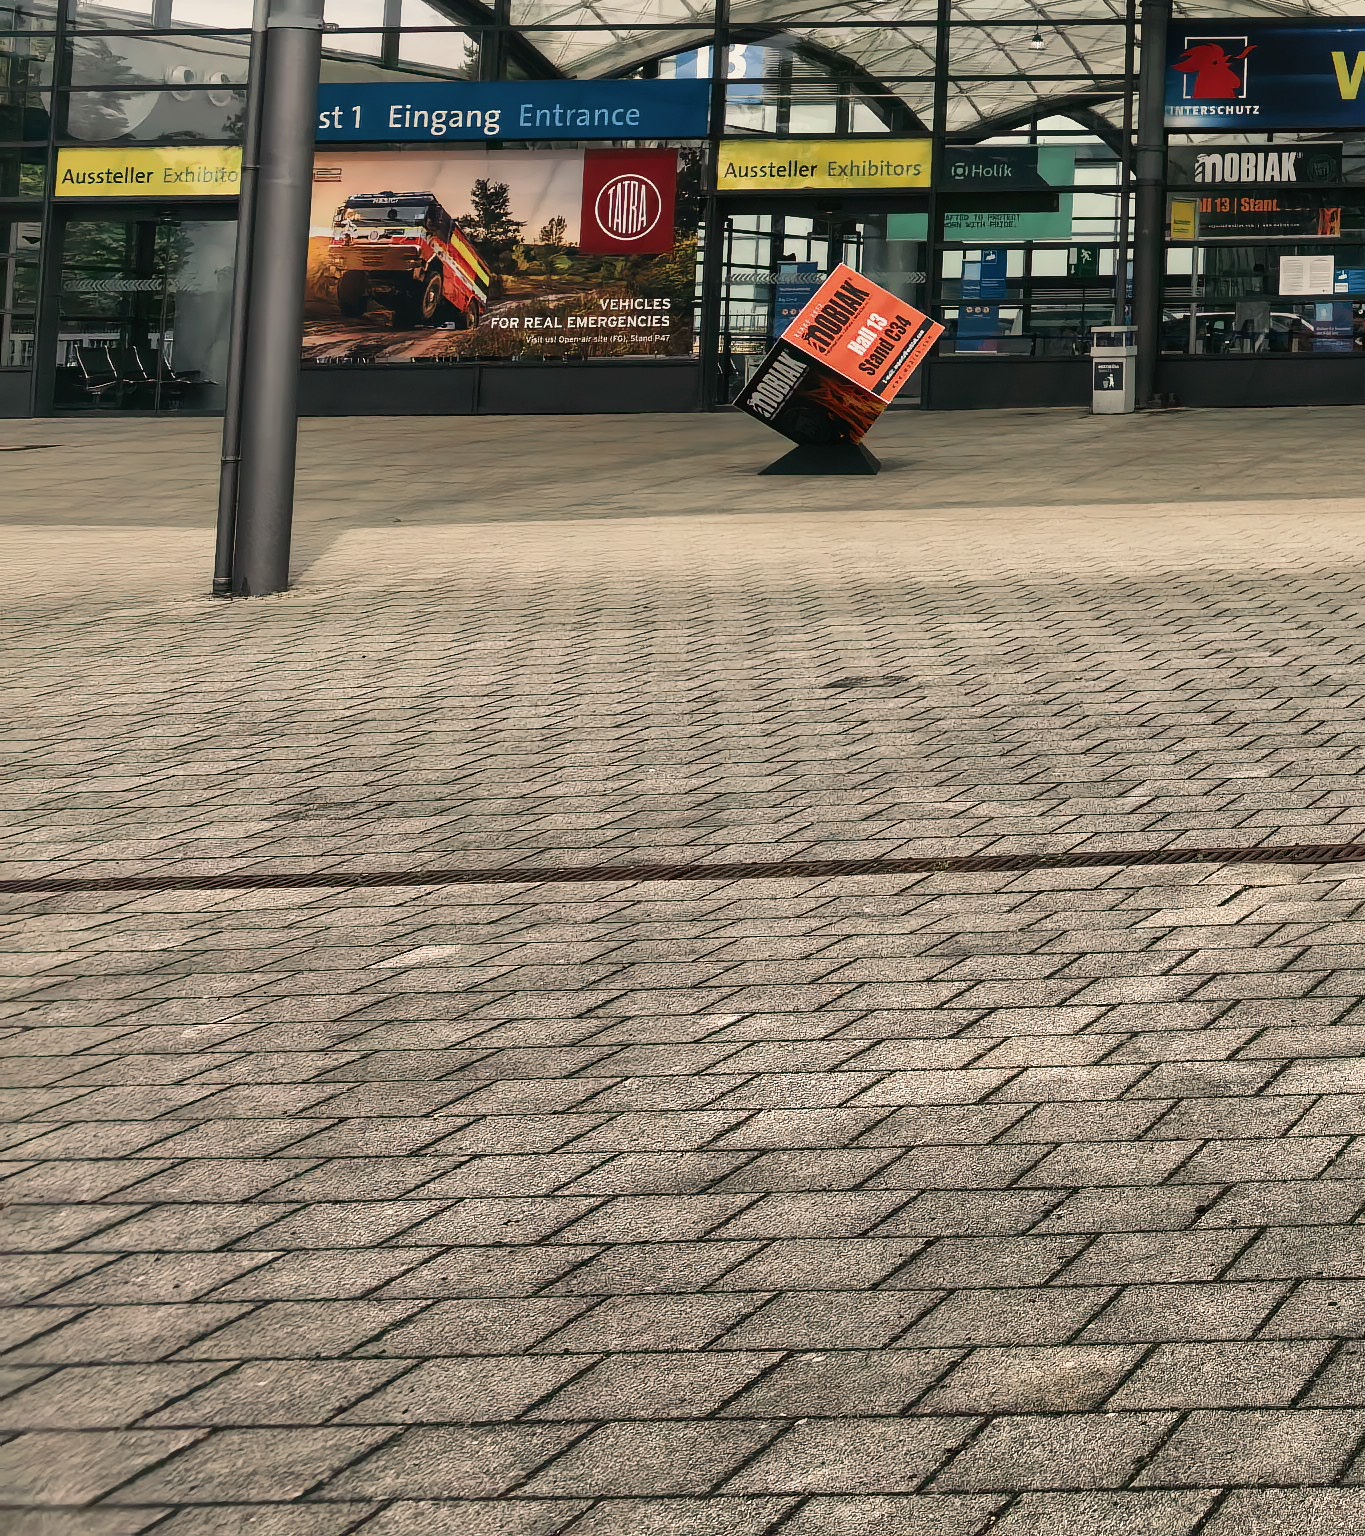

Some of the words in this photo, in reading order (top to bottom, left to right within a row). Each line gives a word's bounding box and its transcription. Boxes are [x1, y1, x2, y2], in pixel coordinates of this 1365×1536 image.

[1169, 104, 1260, 116] INTERSCHUTZ
[318, 105, 343, 129] st
[351, 105, 362, 129] 1
[388, 104, 502, 136] Eingang
[519, 103, 640, 127] Entrance
[61, 167, 154, 184] Aussteller
[163, 167, 238, 183] Exhibito
[723, 159, 818, 178] Aussteller
[827, 159, 922, 177] Exhibitors
[607, 180, 647, 234] TATRA
[1215, 197, 1230, 213] 13
[600, 298, 671, 311] VEHICLES
[490, 317, 518, 329] FOR
[523, 317, 562, 329] REAL
[567, 315, 670, 328] EMERGENCIES
[526, 335, 543, 344] Visit
[630, 334, 652, 343] Stand
[847, 326, 878, 356] Hall
[866, 312, 889, 331] 13
[858, 337, 895, 376] Stand
[884, 314, 912, 342] C34
